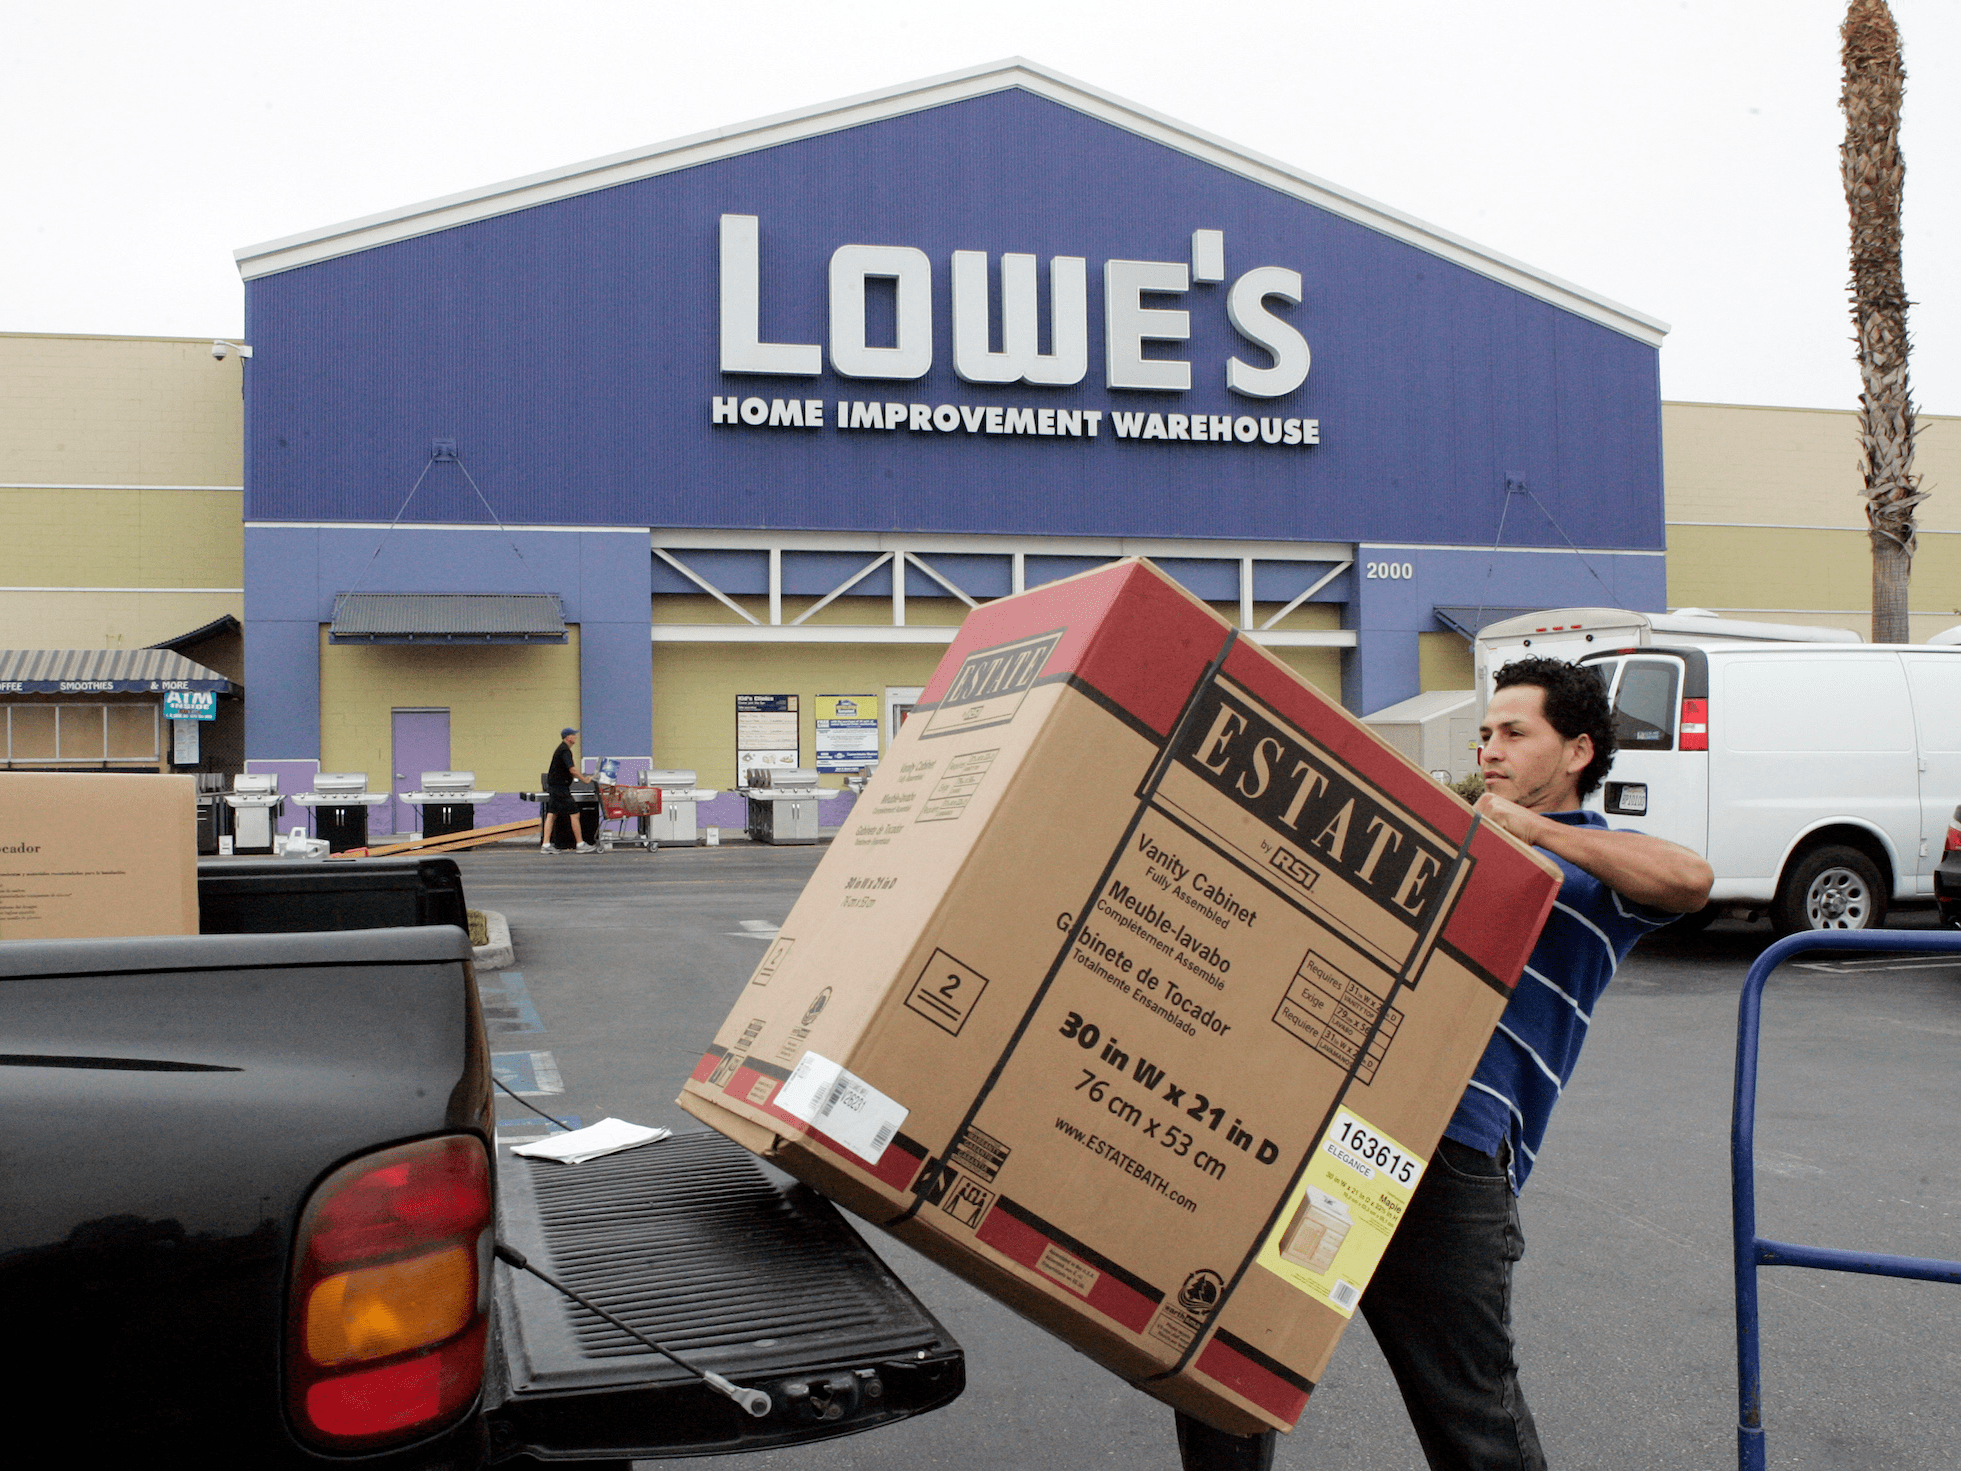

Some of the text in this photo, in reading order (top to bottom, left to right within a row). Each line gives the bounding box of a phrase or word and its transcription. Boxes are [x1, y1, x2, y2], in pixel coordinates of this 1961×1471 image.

[719, 212, 1311, 398] LOWE'S
[712, 396, 1320, 445] HOME IMPROVEMENT WAREHOUSE
[1366, 561, 1413, 580] 2000
[0, 680, 190, 691] FFEE SMOOTHIES & MORE
[947, 645, 1048, 703] ESTATE
[167, 690, 213, 704] ATM
[1191, 701, 1441, 916] ESTATE
[1260, 839, 1272, 853] by
[1138, 832, 1256, 927] Vanity Cabinet
[1145, 865, 1230, 929] Fully Assembled
[1096, 898, 1224, 990] Complètement Assemblé
[1107, 879, 1230, 972] Meuble-lavabo
[939, 973, 963, 1000] 2
[1052, 909, 1231, 1036] Gbinete de Tocador
[1072, 947, 1195, 1036] Totalmente Ensamblado
[1306, 959, 1342, 990] Requires
[1300, 987, 1324, 1009] Exige
[1343, 994, 1374, 1018] VANITY TOP
[1363, 994, 1370, 1002] W
[1390, 1013, 1396, 1021] D
[1281, 1006, 1318, 1037] Requiere
[1331, 1018, 1353, 1035] LAVABO
[1339, 1040, 1347, 1049] W
[1058, 1011, 1278, 1164] 30 in W x 21 in D
[1074, 1068, 1226, 1180] 76 cm x 53 cm
[1055, 1117, 1196, 1212] www.ESTATEBATH.com
[1327, 1144, 1371, 1176] ELEGANCE
[1340, 1122, 1414, 1182] 163615
[1379, 1194, 1401, 1214] Maple
